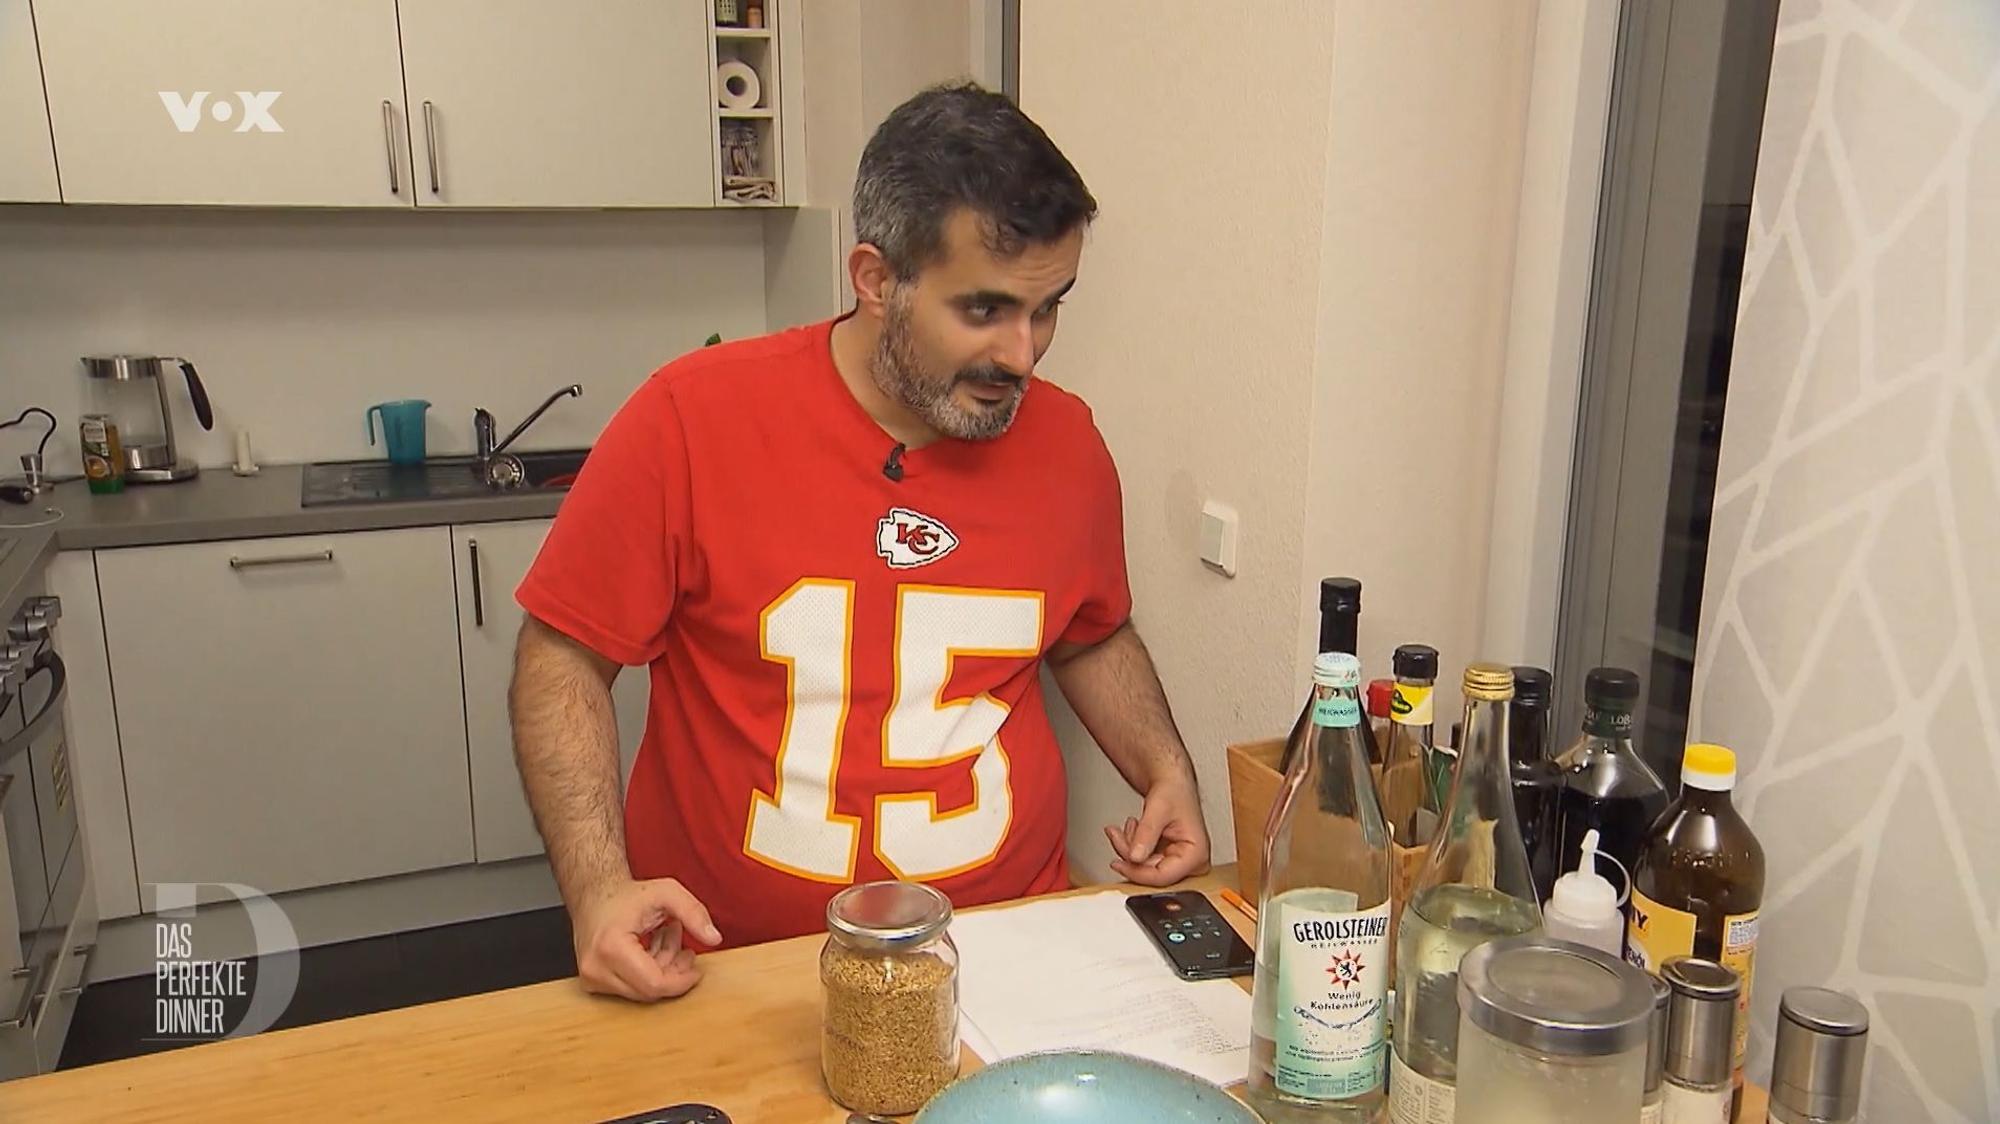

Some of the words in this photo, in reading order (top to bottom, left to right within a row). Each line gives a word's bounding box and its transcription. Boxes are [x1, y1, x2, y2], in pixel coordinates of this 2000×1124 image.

[896, 523, 940, 555] KC
[743, 576, 1045, 884] 15
[1293, 916, 1388, 943] GEROLSTEINER
[1328, 991, 1361, 1001] Wenig
